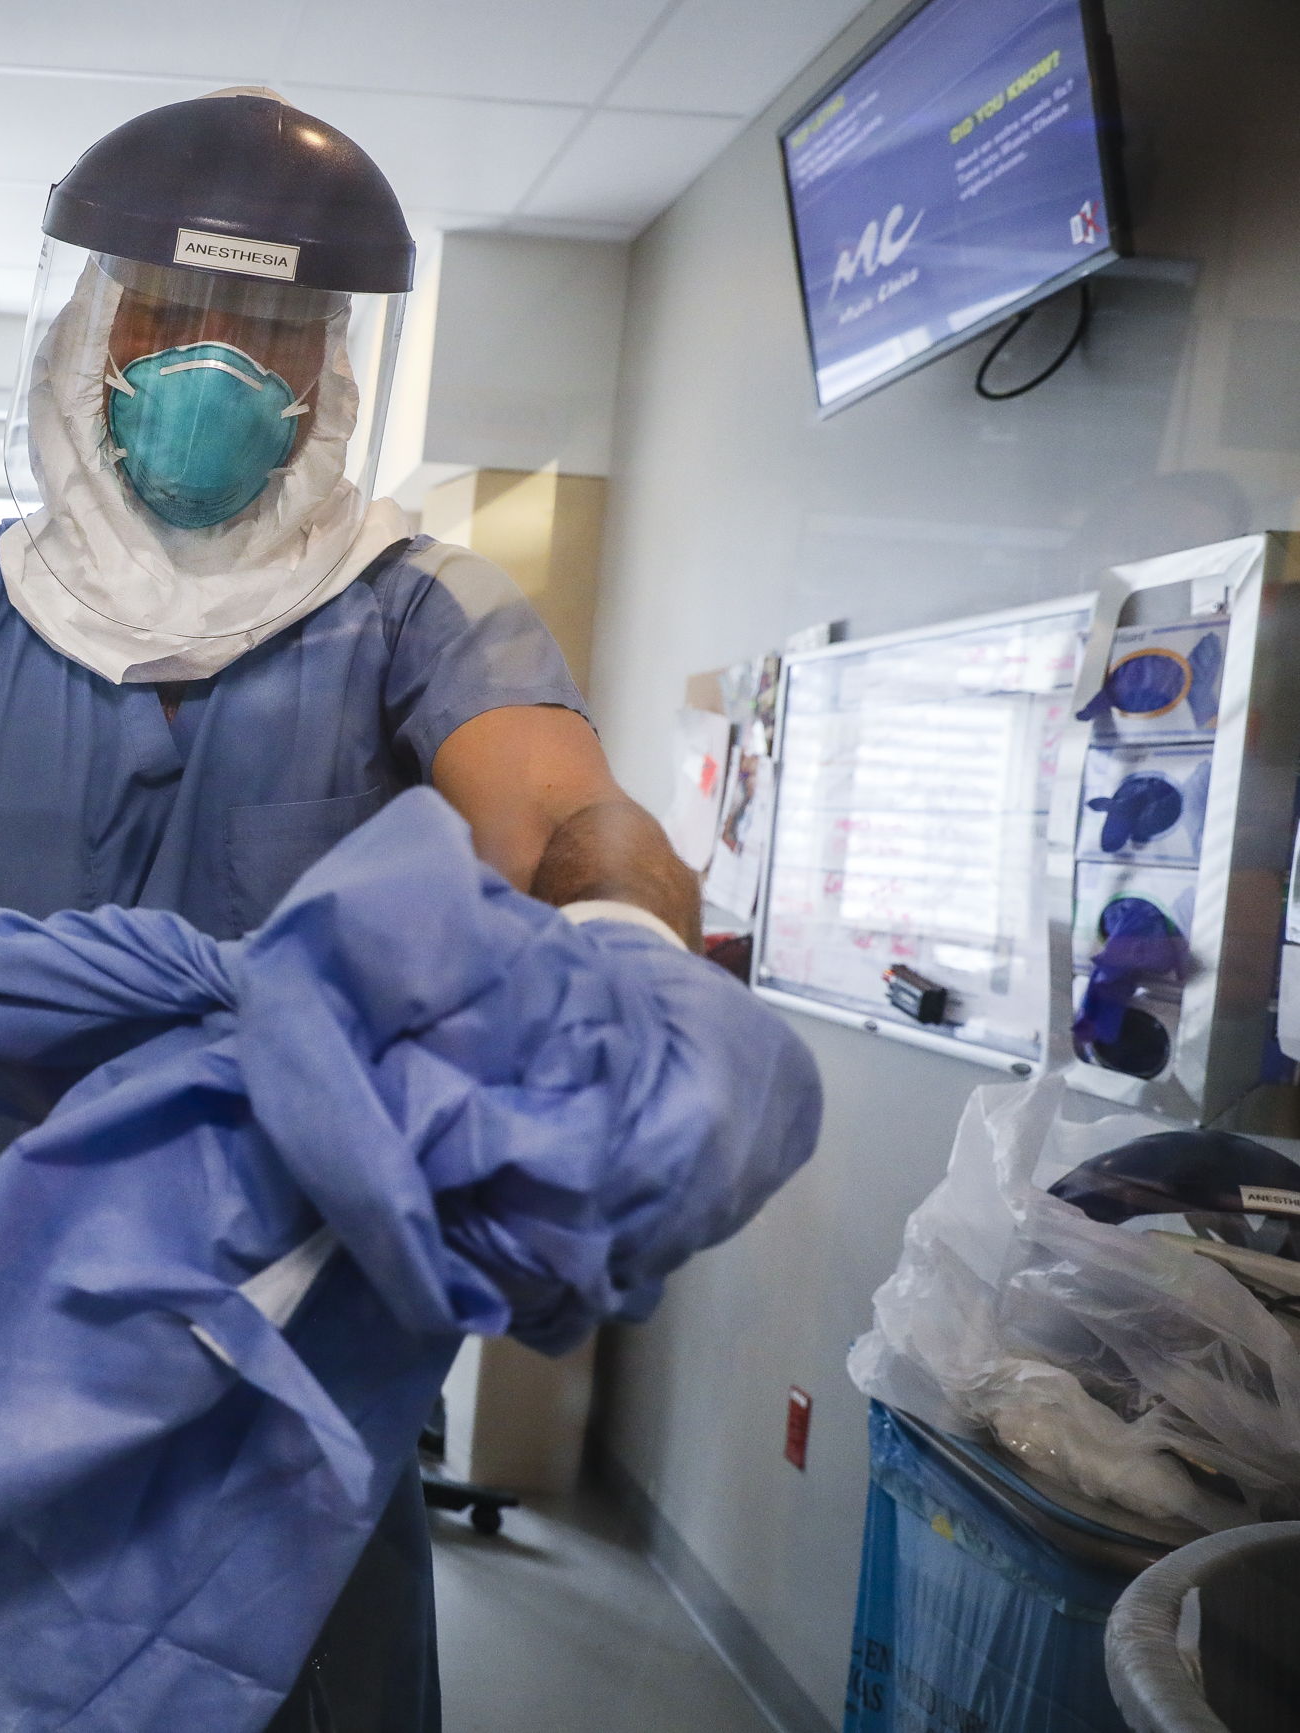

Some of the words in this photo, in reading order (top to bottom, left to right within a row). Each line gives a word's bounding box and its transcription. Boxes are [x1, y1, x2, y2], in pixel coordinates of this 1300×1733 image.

[950, 116, 974, 144] DID
[975, 92, 1005, 124] YOU
[1007, 49, 1062, 101] KNOW?
[185, 242, 288, 268] ANESTHESIA
